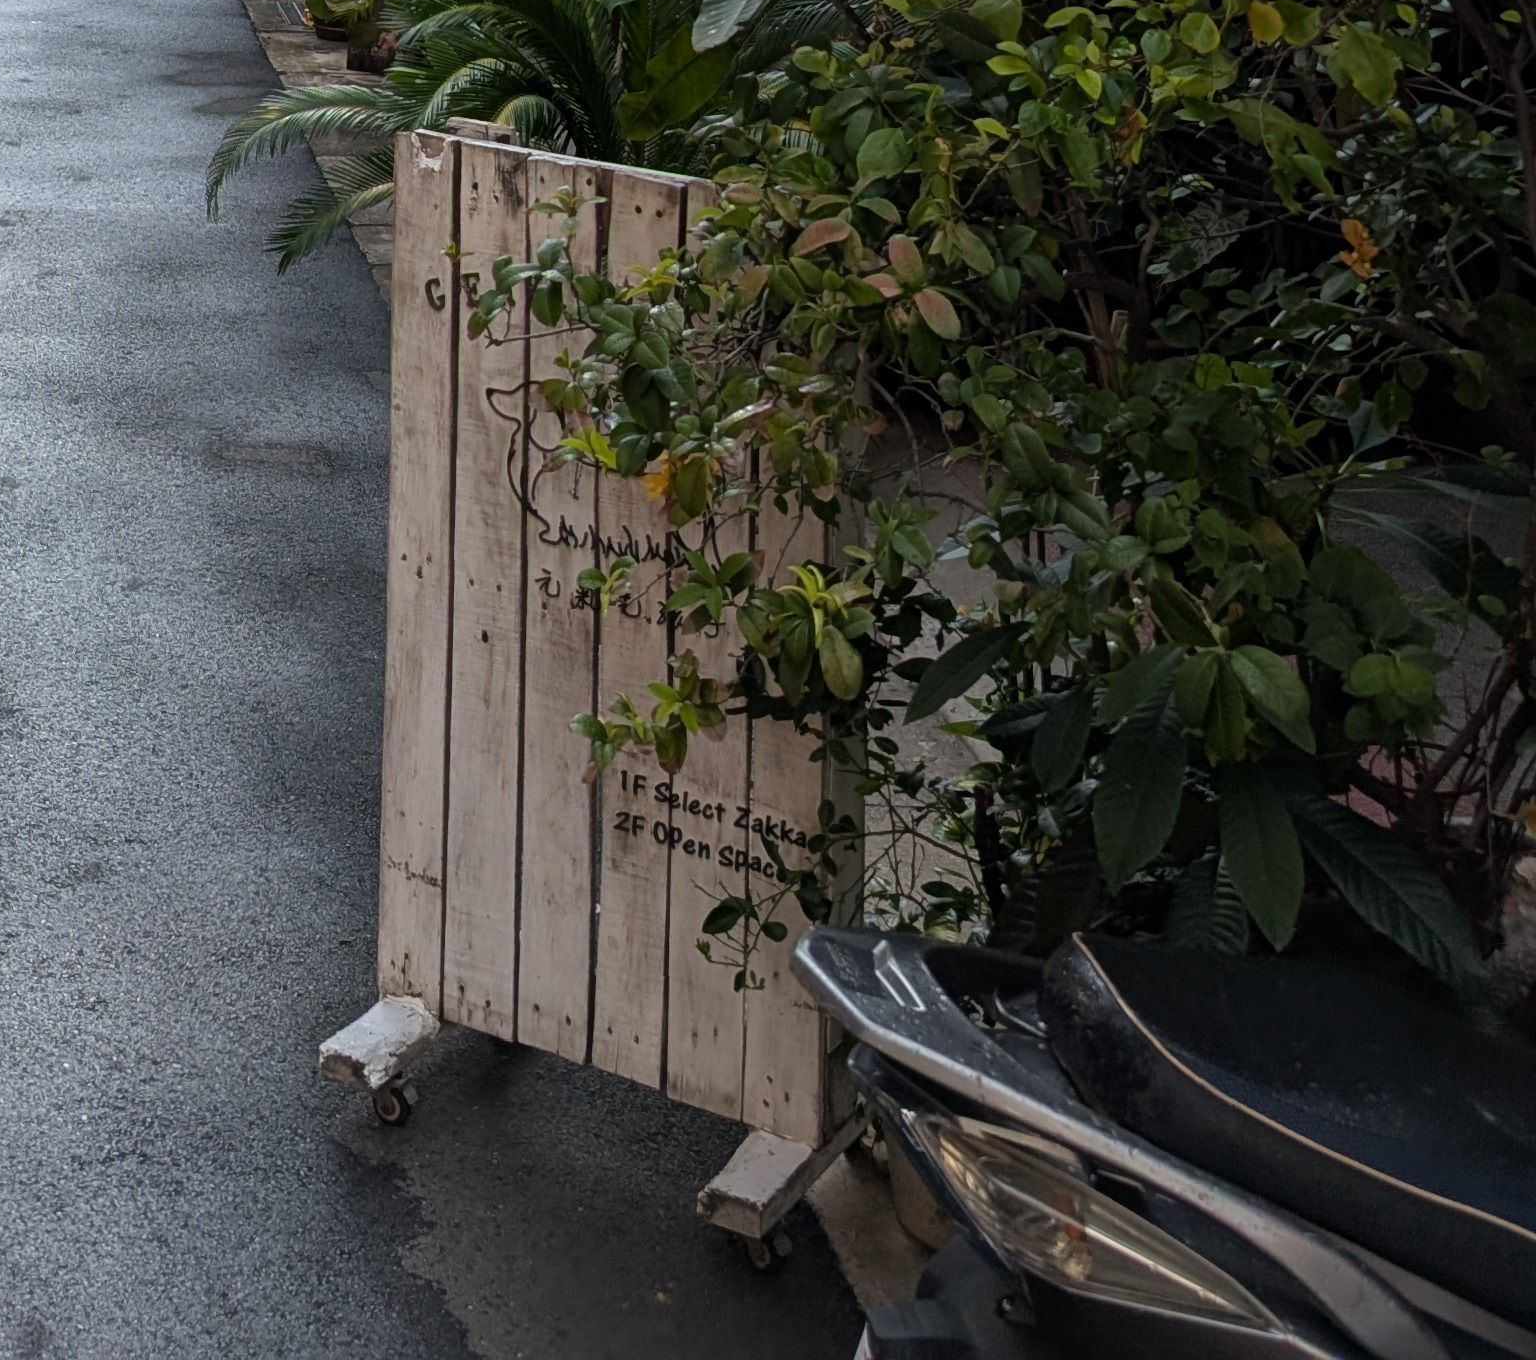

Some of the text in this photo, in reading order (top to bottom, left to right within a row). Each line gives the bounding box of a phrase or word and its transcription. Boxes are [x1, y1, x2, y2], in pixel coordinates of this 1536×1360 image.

[613, 811, 647, 837] 2F
[717, 844, 776, 879] Spac
[653, 781, 727, 824] Select
[732, 805, 807, 849] Zakka
